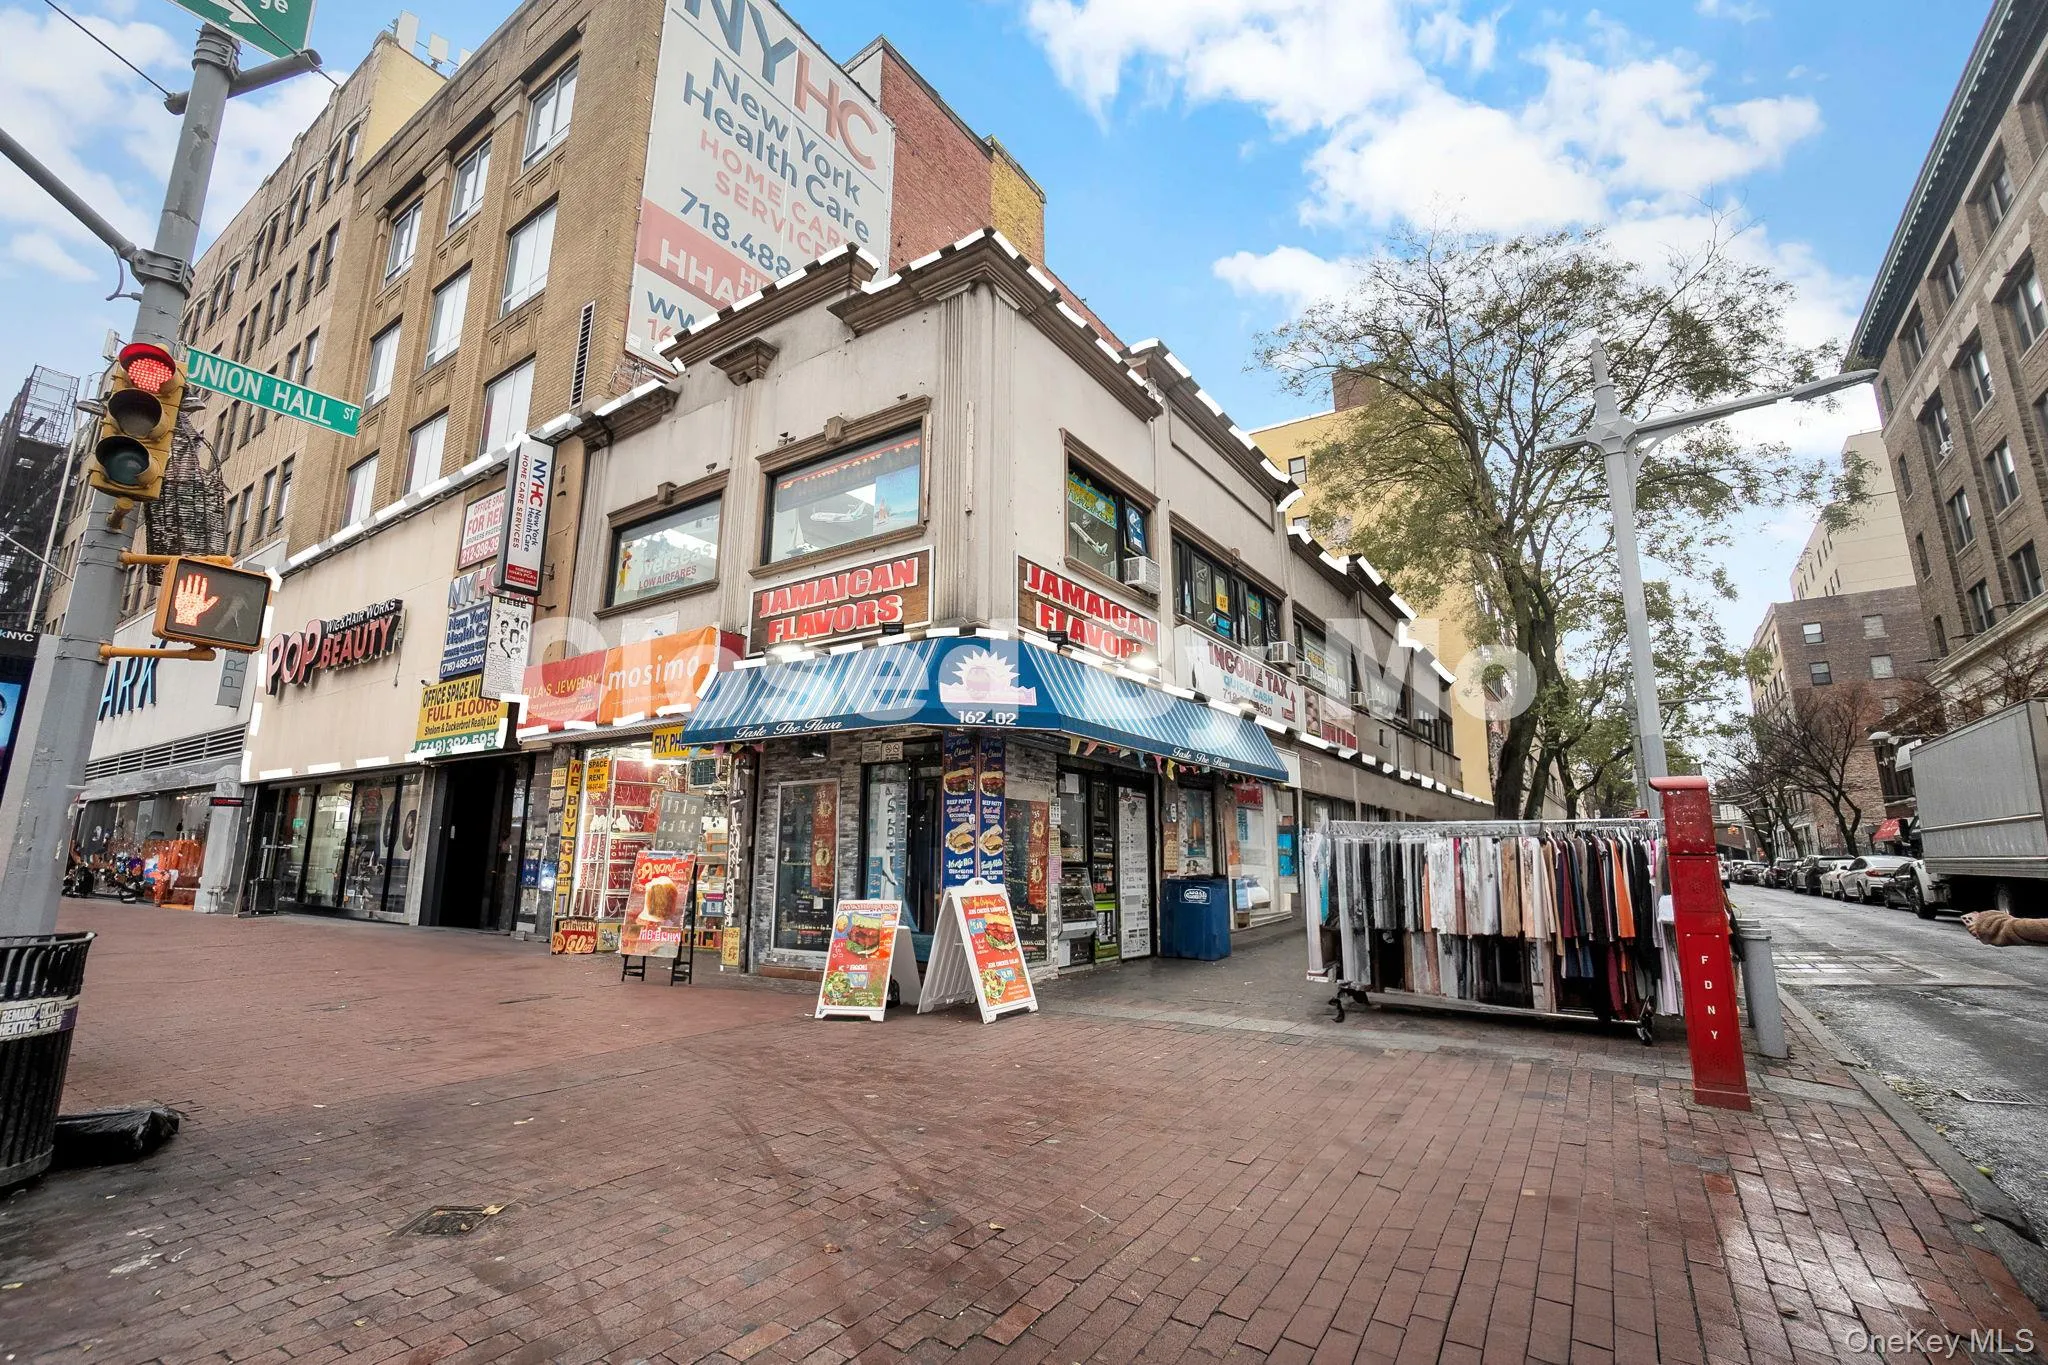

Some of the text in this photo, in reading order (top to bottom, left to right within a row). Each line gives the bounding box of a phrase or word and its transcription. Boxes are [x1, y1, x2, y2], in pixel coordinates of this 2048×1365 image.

[712, 57, 861, 207] New York
[683, 71, 869, 243] Health Care
[700, 129, 783, 208] HOME
[187, 355, 356, 426] UNION HALL ST
[528, 459, 548, 508] NYHC
[512, 455, 529, 549] HOME CARE SERVICES
[467, 515, 484, 536] FOR
[759, 557, 918, 618] JAMAICAN
[365, 599, 396, 620] WORKS
[1024, 563, 1158, 646] JAMAICAN
[449, 617, 468, 631] New
[768, 594, 903, 644] FLAVORS
[320, 615, 399, 669] BEAUTY
[446, 623, 487, 645] Health Ca
[266, 619, 322, 695] POP
[555, 672, 599, 695] JEWELRY
[1208, 641, 1264, 688] INCOME
[1265, 669, 1289, 700] TAX
[423, 678, 480, 708] OFFICE SPACE AV
[427, 700, 500, 723] FULL FLOORS
[487, 714, 498, 725] LLC
[958, 711, 1017, 726] 162-02
[734, 726, 767, 739] Taste
[773, 722, 801, 735] The
[654, 735, 668, 754] FIX
[1172, 747, 1192, 760] Taste
[1195, 751, 1209, 764] The
[588, 761, 608, 769] SPACE
[589, 774, 604, 782] RENT
